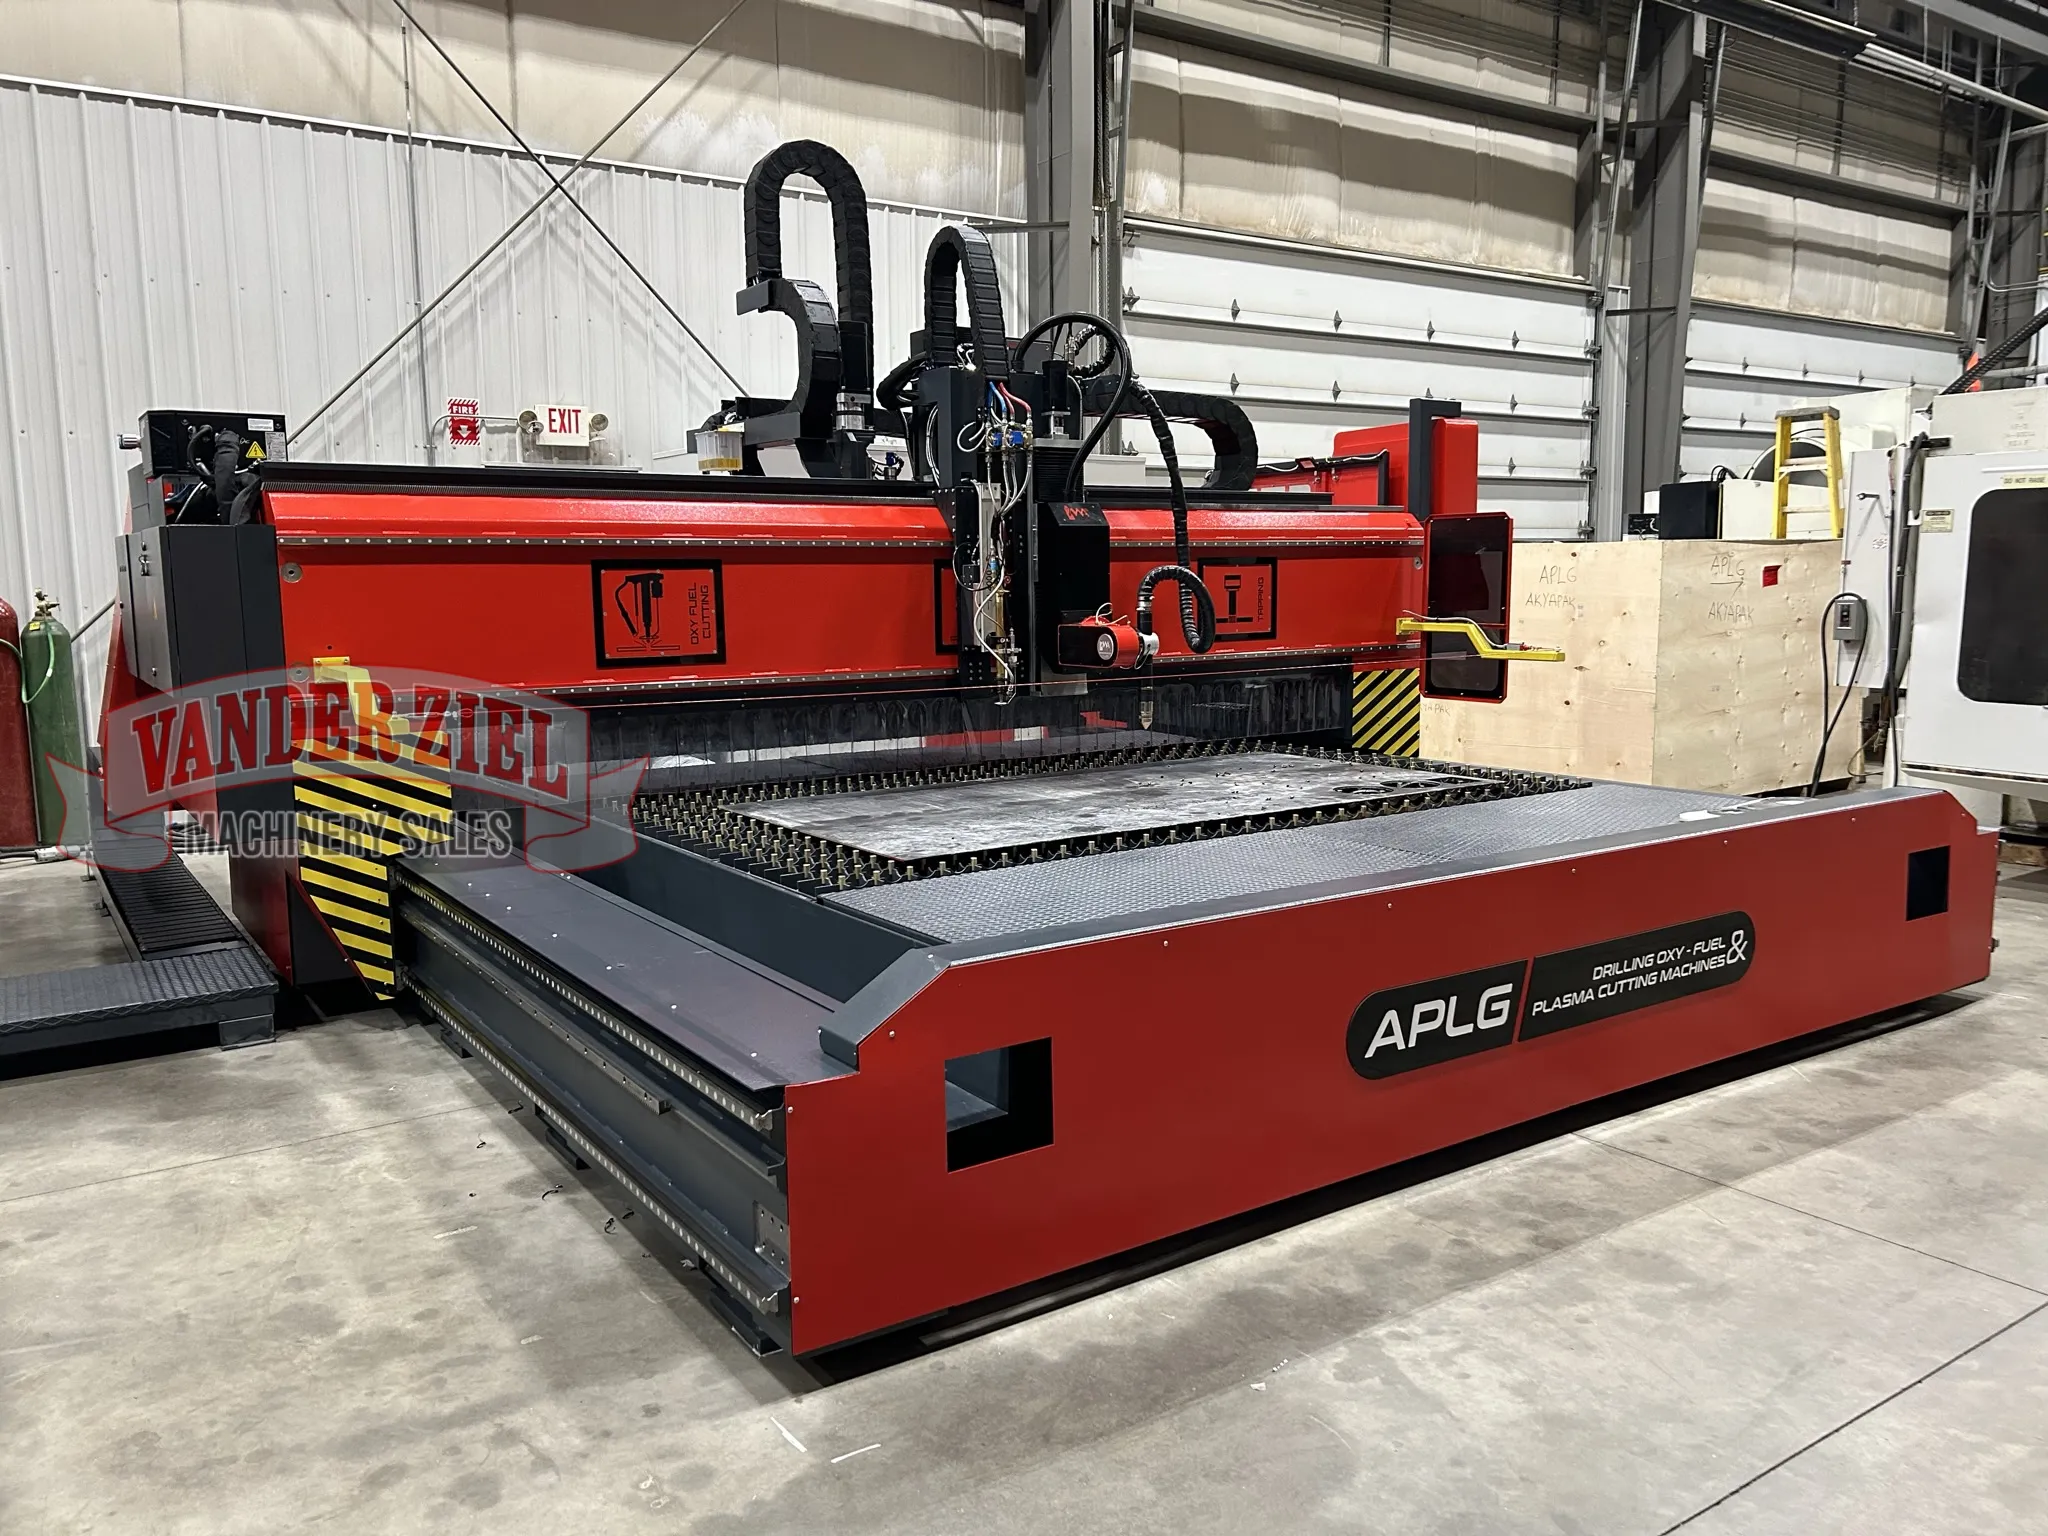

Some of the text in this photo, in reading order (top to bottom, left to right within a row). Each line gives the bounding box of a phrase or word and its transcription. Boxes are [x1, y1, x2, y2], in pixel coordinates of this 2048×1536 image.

[452, 405, 474, 414] FIRE
[548, 408, 581, 434] EXIT
[1539, 565, 1577, 584] APLG
[1711, 556, 1745, 577] APLG
[688, 582, 699, 645] OXY FUEL
[701, 584, 711, 639] CUTTING
[1525, 592, 1576, 612] AKYAPAK
[1708, 601, 1754, 624] AKYAPAK
[1592, 954, 1654, 981] DRILLING
[1656, 946, 1685, 965] OXY
[1692, 937, 1726, 956] FUEL
[1726, 929, 1748, 965] &
[1532, 954, 1726, 1016] PLASMA CUTTING MACHINES
[1364, 983, 1513, 1059] APLG
